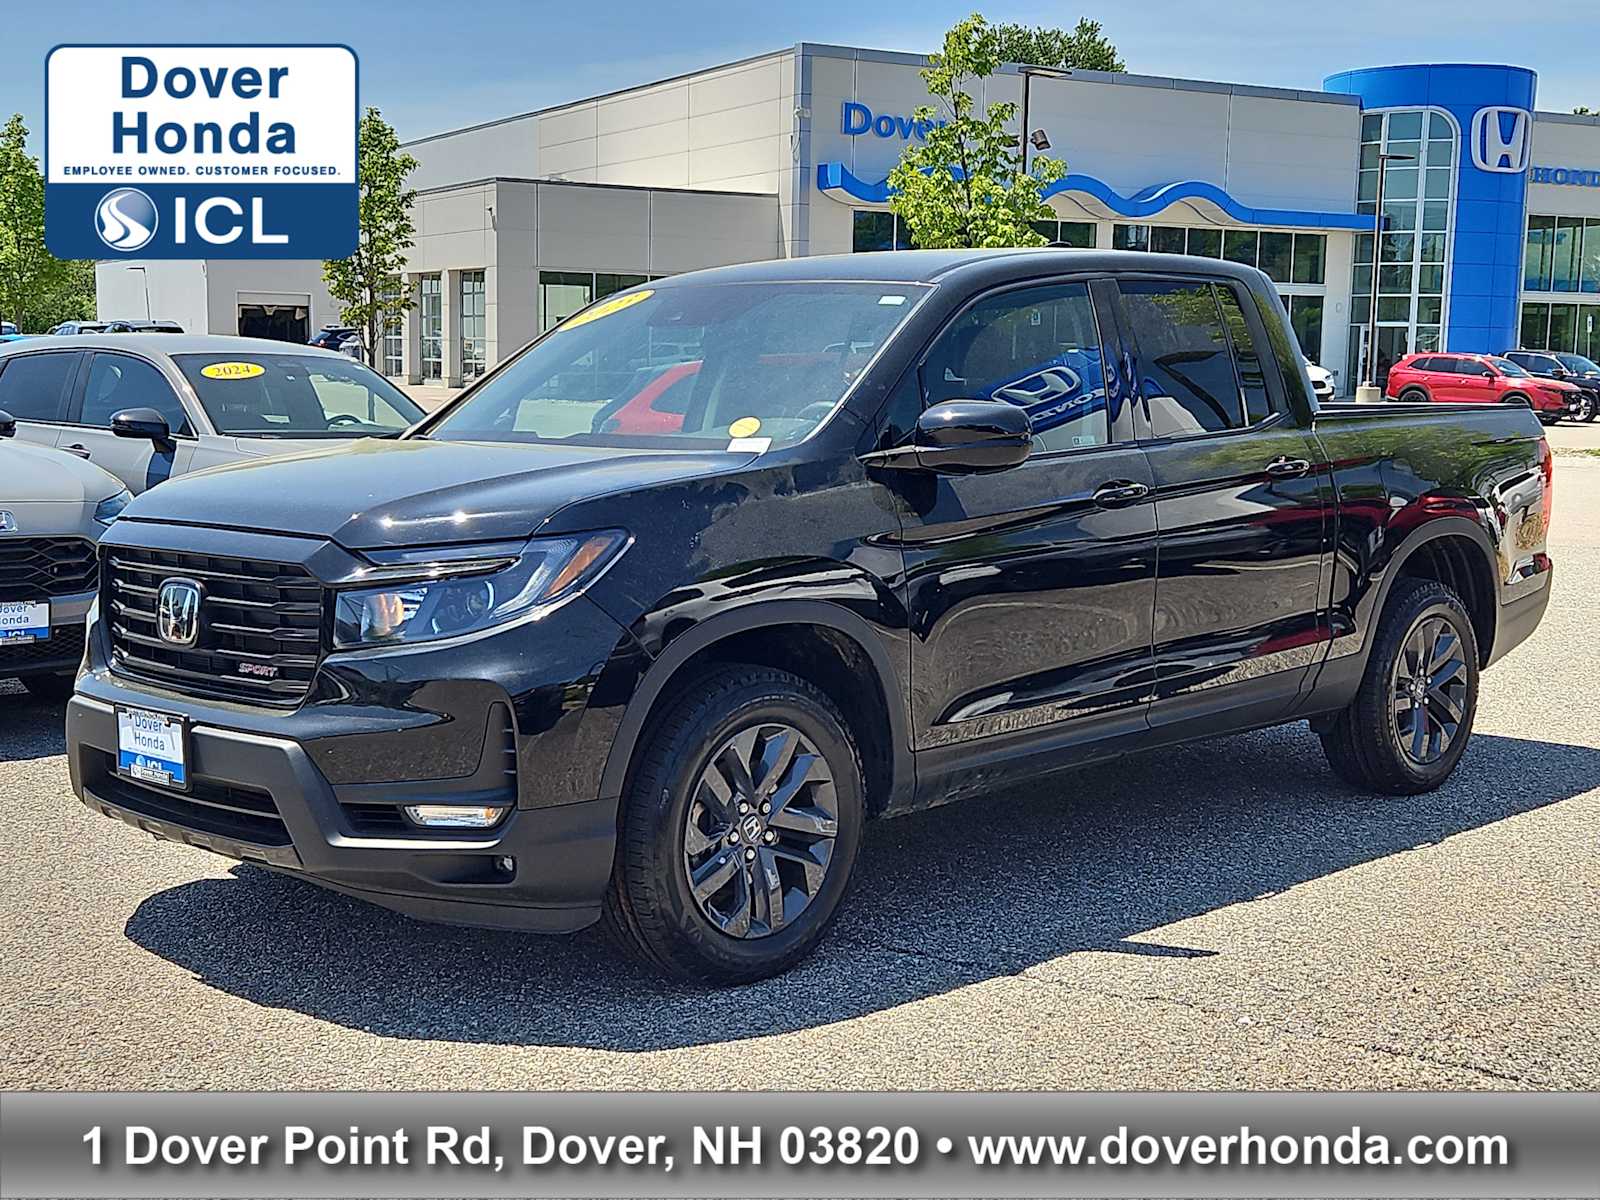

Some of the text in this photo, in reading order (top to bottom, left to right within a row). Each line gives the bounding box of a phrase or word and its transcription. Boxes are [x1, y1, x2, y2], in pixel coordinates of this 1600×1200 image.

[213, 365, 251, 376] 2024
[0, 605, 27, 614] over
[0, 615, 29, 625] onda
[239, 663, 278, 677] SPORT
[135, 715, 162, 732] Dover
[134, 732, 165, 751] Honda
